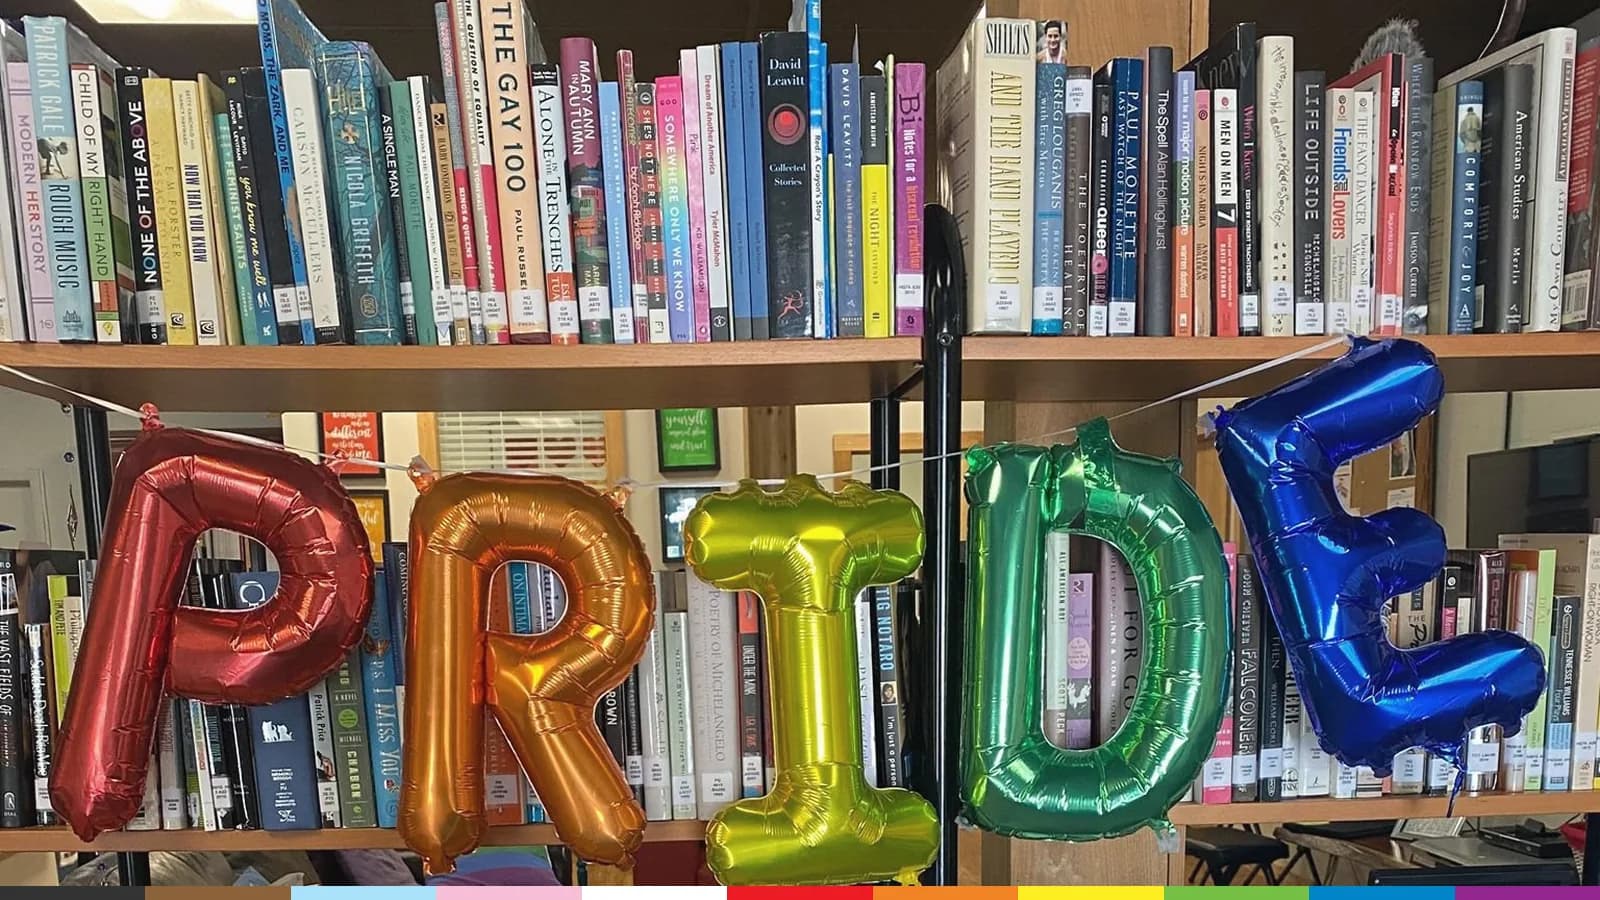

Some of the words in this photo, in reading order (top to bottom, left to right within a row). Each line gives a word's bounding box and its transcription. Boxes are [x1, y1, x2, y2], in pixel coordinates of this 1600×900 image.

[467, 24, 479, 75] QUESTION
[492, 2, 516, 63] THE
[985, 23, 1031, 55] SHILTS
[33, 24, 61, 89] PATRICK
[266, 58, 276, 80] THE
[769, 58, 801, 71] David
[77, 72, 94, 119] CHILD
[473, 79, 481, 93] OF
[571, 73, 579, 83] IN
[579, 60, 593, 104] MARY
[704, 75, 712, 100] Dream
[767, 74, 806, 87] Leavitt
[842, 68, 850, 107] DAVID
[990, 71, 1022, 106] AND
[39, 96, 65, 133] GALE
[498, 73, 522, 132] GAY
[899, 93, 923, 126] Bi
[1052, 76, 1065, 122] GREG
[1118, 91, 1126, 118] LAST
[1126, 90, 1140, 142] PAUL
[1157, 90, 1169, 115] The
[1304, 83, 1320, 130] LIFE
[82, 125, 96, 146] OF
[128, 101, 146, 162] ABOVE
[275, 126, 287, 151] AND
[475, 98, 486, 146] EQUALITY
[538, 89, 556, 159] ALONE
[568, 84, 585, 156] AUTUMN
[582, 106, 596, 140] ANN
[643, 110, 653, 139] SHE'S
[706, 111, 715, 142] Another
[990, 114, 1022, 149] THE
[1155, 116, 1169, 148] Spell
[1180, 121, 1191, 155] major
[1220, 120, 1231, 146] MEN
[1242, 104, 1255, 139] When
[1357, 118, 1369, 136] THE
[293, 107, 311, 175] CARSON
[383, 127, 398, 167] SINGLE
[645, 143, 654, 164] NOT
[843, 115, 852, 168] LEAVITT
[903, 129, 917, 156] Notes
[1117, 124, 1125, 165] WATCH
[1220, 150, 1231, 167] ON
[1333, 127, 1351, 181] Friends
[1356, 141, 1369, 176] FANCY
[1515, 110, 1528, 170] American
[85, 152, 98, 176] MY
[184, 165, 200, 185] NOW
[279, 156, 290, 174] ME
[503, 143, 527, 193] 100
[664, 115, 679, 203] SOMEWHERE
[708, 144, 717, 175] America
[769, 163, 806, 173] Collected
[904, 158, 917, 176] for
[1051, 126, 1065, 209] LOUGANIS
[1116, 170, 1125, 184] OF
[1157, 151, 1168, 180] Alan
[1181, 156, 1192, 195] motion
[1198, 145, 1207, 182] NIGHTS
[17, 114, 35, 184] MODERN
[26, 190, 46, 275] HERSTORY
[134, 166, 150, 202] THE
[225, 161, 243, 212] FEMINIST
[345, 157, 367, 209] NICOLA
[388, 168, 400, 198] MAN
[646, 167, 657, 204] THERE
[773, 178, 803, 187] Stories
[813, 164, 822, 198] Crayon's
[990, 156, 1022, 200] BAND
[1078, 174, 1088, 208] THE
[1220, 171, 1232, 197] MEN
[1304, 138, 1320, 220] OUTSIDE
[48, 184, 73, 235] ROUGH
[89, 181, 105, 227] RIGHT
[187, 189, 203, 210] THAT
[813, 200, 824, 222] Story
[1116, 191, 1124, 213] THE
[1124, 156, 1138, 259] MONETTE
[1153, 180, 1169, 249] Hollinghurst
[1217, 208, 1236, 223] 7
[1332, 191, 1351, 240] Lovers
[1355, 180, 1368, 224] DANCER
[1462, 157, 1476, 240] COMFORT
[1512, 174, 1526, 220] Studies
[137, 205, 152, 229] OF
[190, 215, 204, 232] YOU
[514, 209, 525, 241] PAUL
[545, 177, 564, 274] TRENCHES
[669, 207, 682, 245] ONLY
[870, 208, 880, 248] NIGHT
[1179, 197, 1191, 236] picture
[1245, 220, 1253, 242] ROBERT
[93, 232, 109, 277] HAND
[192, 236, 207, 262] KNOW
[233, 224, 247, 270] SAINTS
[352, 217, 376, 284] GRIFFITH
[713, 229, 721, 268] McMahon
[989, 208, 1021, 270] PLAYED
[1115, 219, 1124, 258] NIGHT
[55, 240, 79, 289] MUSIC
[140, 232, 157, 284] NONE
[671, 248, 683, 267] WE
[1077, 223, 1087, 296] POETRY
[1304, 243, 1313, 296] SIGNORILE
[1511, 247, 1521, 285] Merlis
[673, 270, 686, 312] KNOW
[1063, 244, 1073, 329] HEALING
[1460, 263, 1473, 293] JOY
[1076, 308, 1086, 329] OF
[875, 587, 890, 611] TIG
[1243, 568, 1252, 597] JOHN
[49, 338, 1547, 886] PRIDE
[708, 590, 721, 638] POETRY
[1408, 615, 1425, 623] THE
[1586, 582, 1597, 624] RIGHT-ON
[1123, 610, 1139, 662] FOR
[1241, 600, 1251, 645] CHEEVER
[878, 617, 894, 671] NOTARO
[1582, 623, 1594, 663] WOMAN
[1565, 649, 1574, 686] TENNESSEE
[2, 703, 13, 716] OF
[313, 694, 324, 721] Patrick
[1057, 677, 1066, 705] SCOTT
[1239, 648, 1258, 756] FALCONER
[1562, 686, 1572, 717] WILLIAMS
[376, 703, 396, 744] MISS
[712, 661, 727, 762] MICHELANGELO
[887, 716, 895, 730] I'm
[1056, 711, 1065, 735] PECK
[315, 722, 327, 742] Price
[886, 731, 896, 748] just
[347, 750, 361, 798] CHABON
[380, 750, 401, 777] YOU
[888, 757, 898, 787] person
